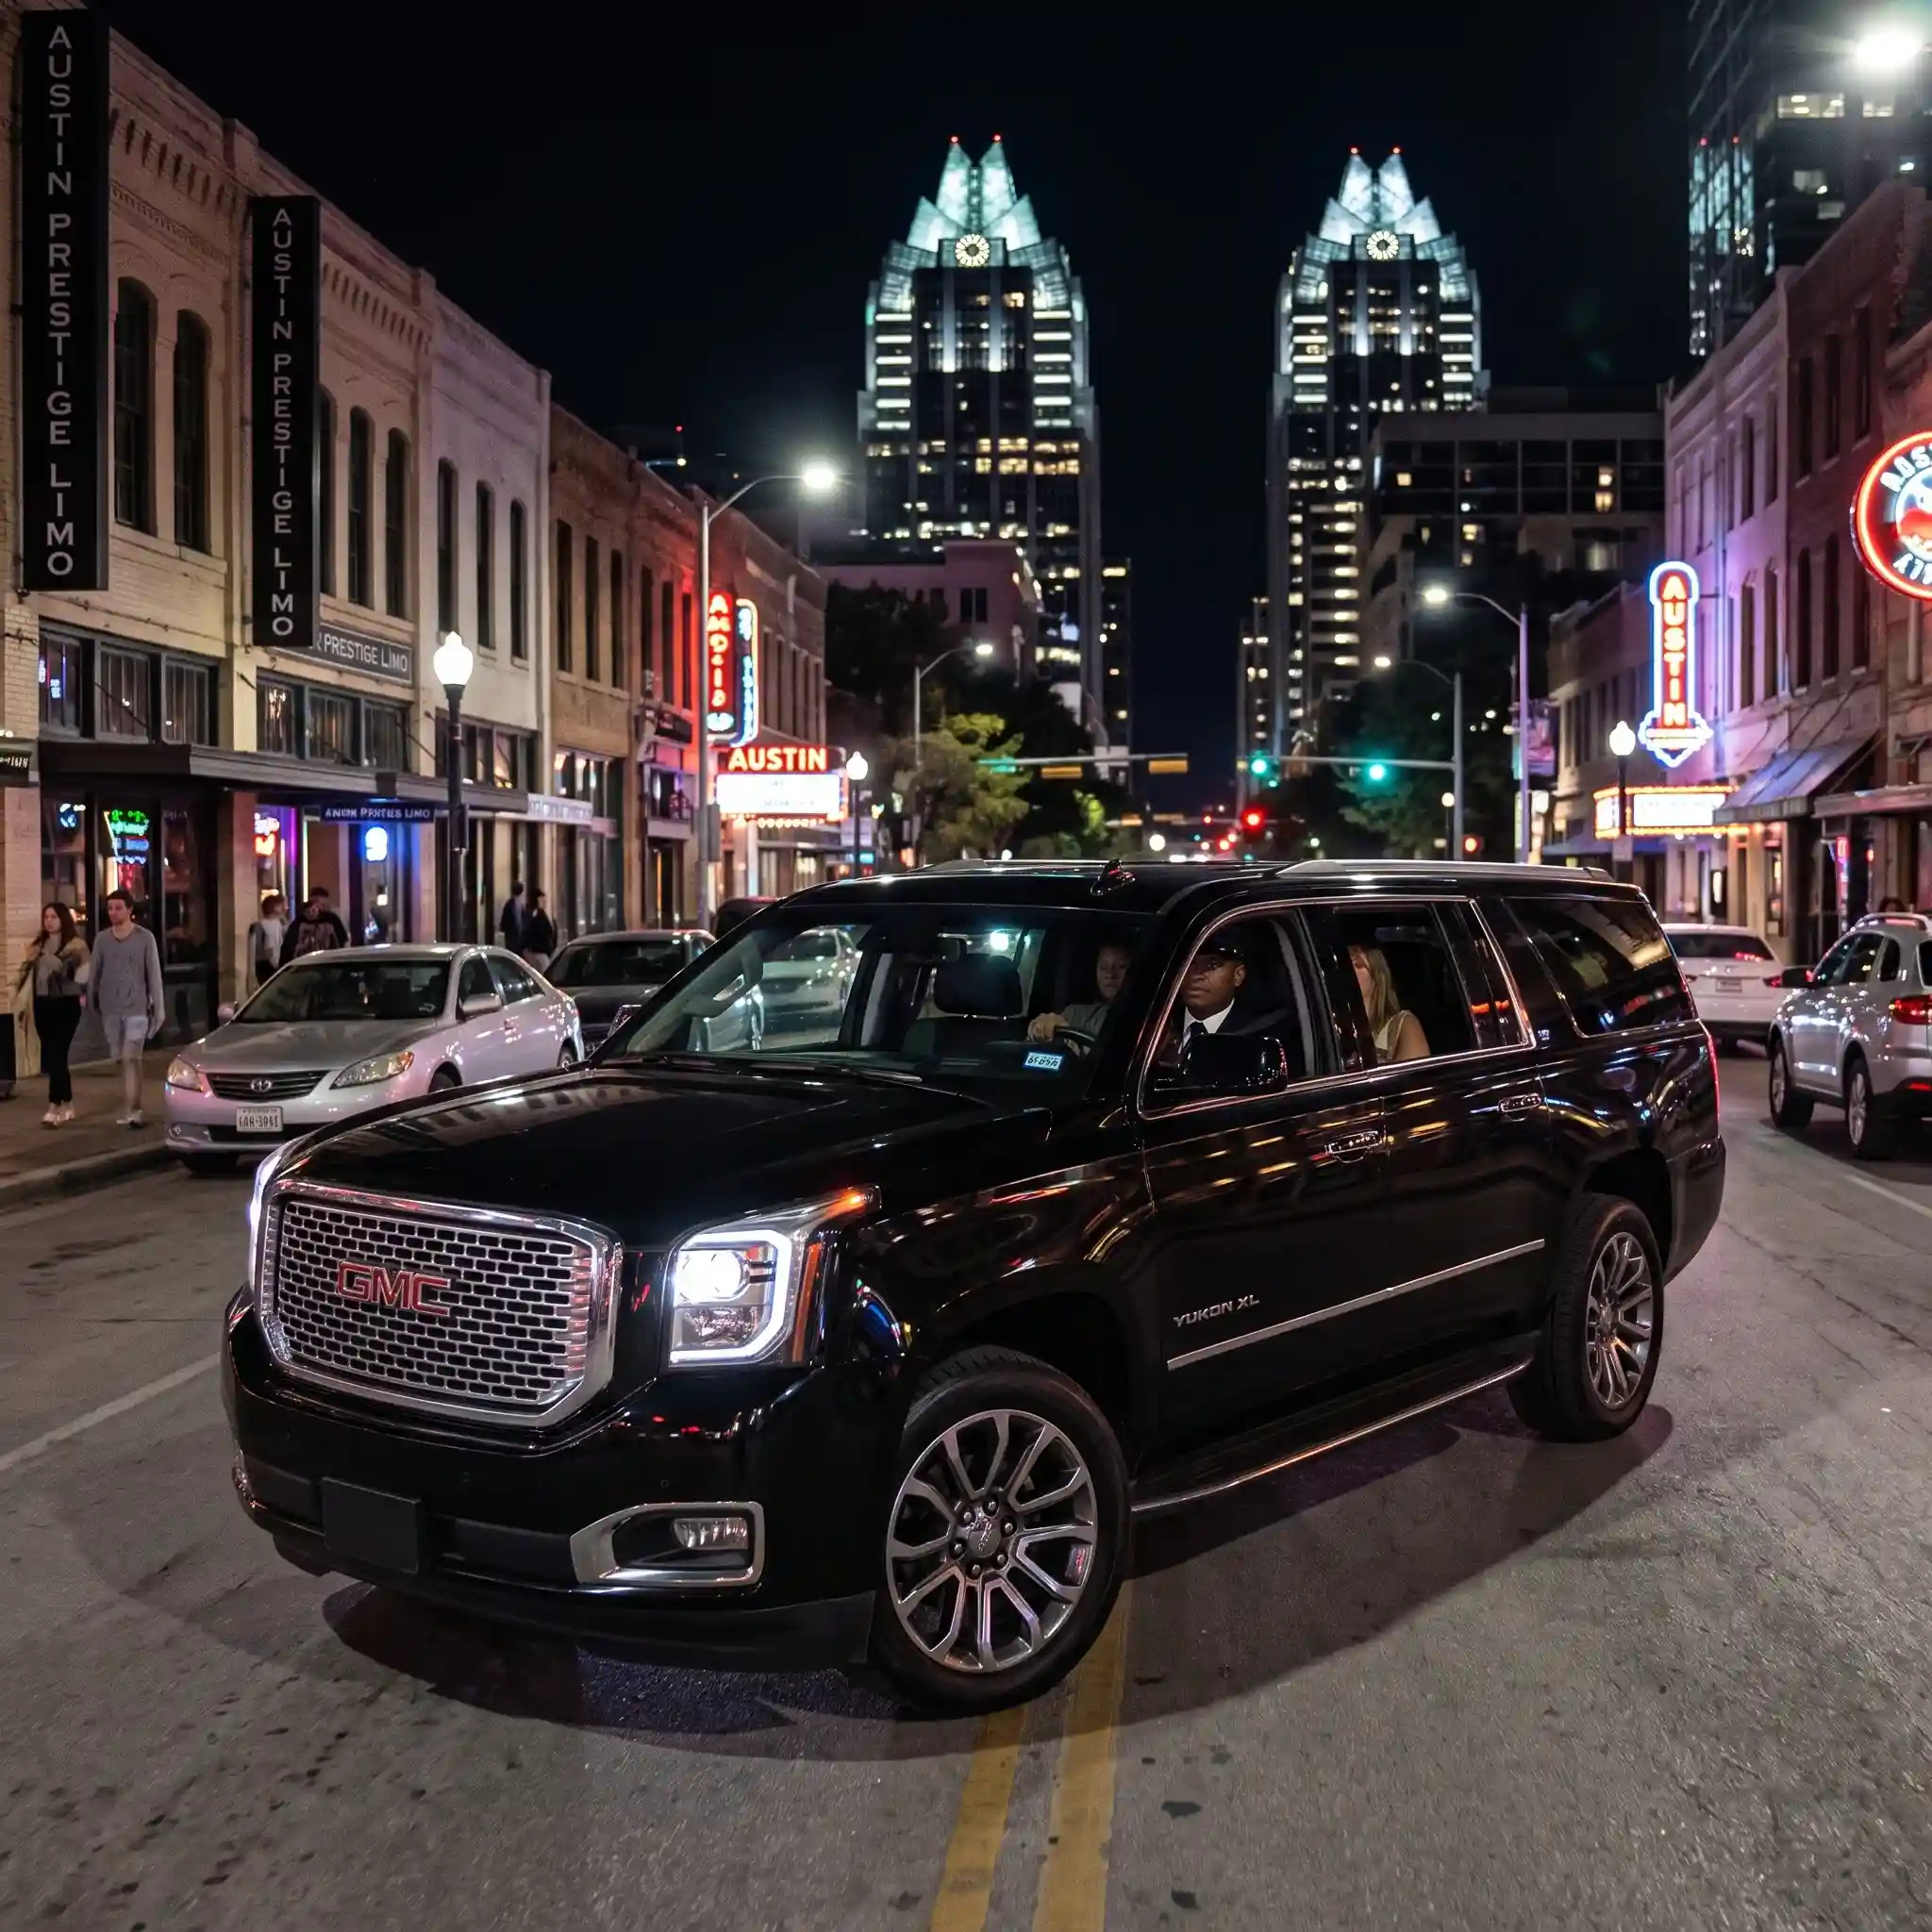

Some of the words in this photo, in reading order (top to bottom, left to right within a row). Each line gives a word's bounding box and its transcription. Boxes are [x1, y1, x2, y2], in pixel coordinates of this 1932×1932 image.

[47, 25, 73, 195] AUSTIN
[46, 213, 73, 445] PRESTIGE
[273, 208, 292, 341] AUSTIN
[272, 353, 293, 535] PRESTIGE
[46, 462, 75, 576] LIMO
[271, 547, 294, 637] LIMO
[324, 633, 378, 665] PRESTIGE
[381, 646, 408, 673] LIMO
[1661, 575, 1687, 726] AUSTIN
[727, 746, 827, 772] AUSTIN
[337, 1260, 451, 1318] GMC
[1173, 1301, 1233, 1327] YUKON
[1237, 1294, 1260, 1310] XL
